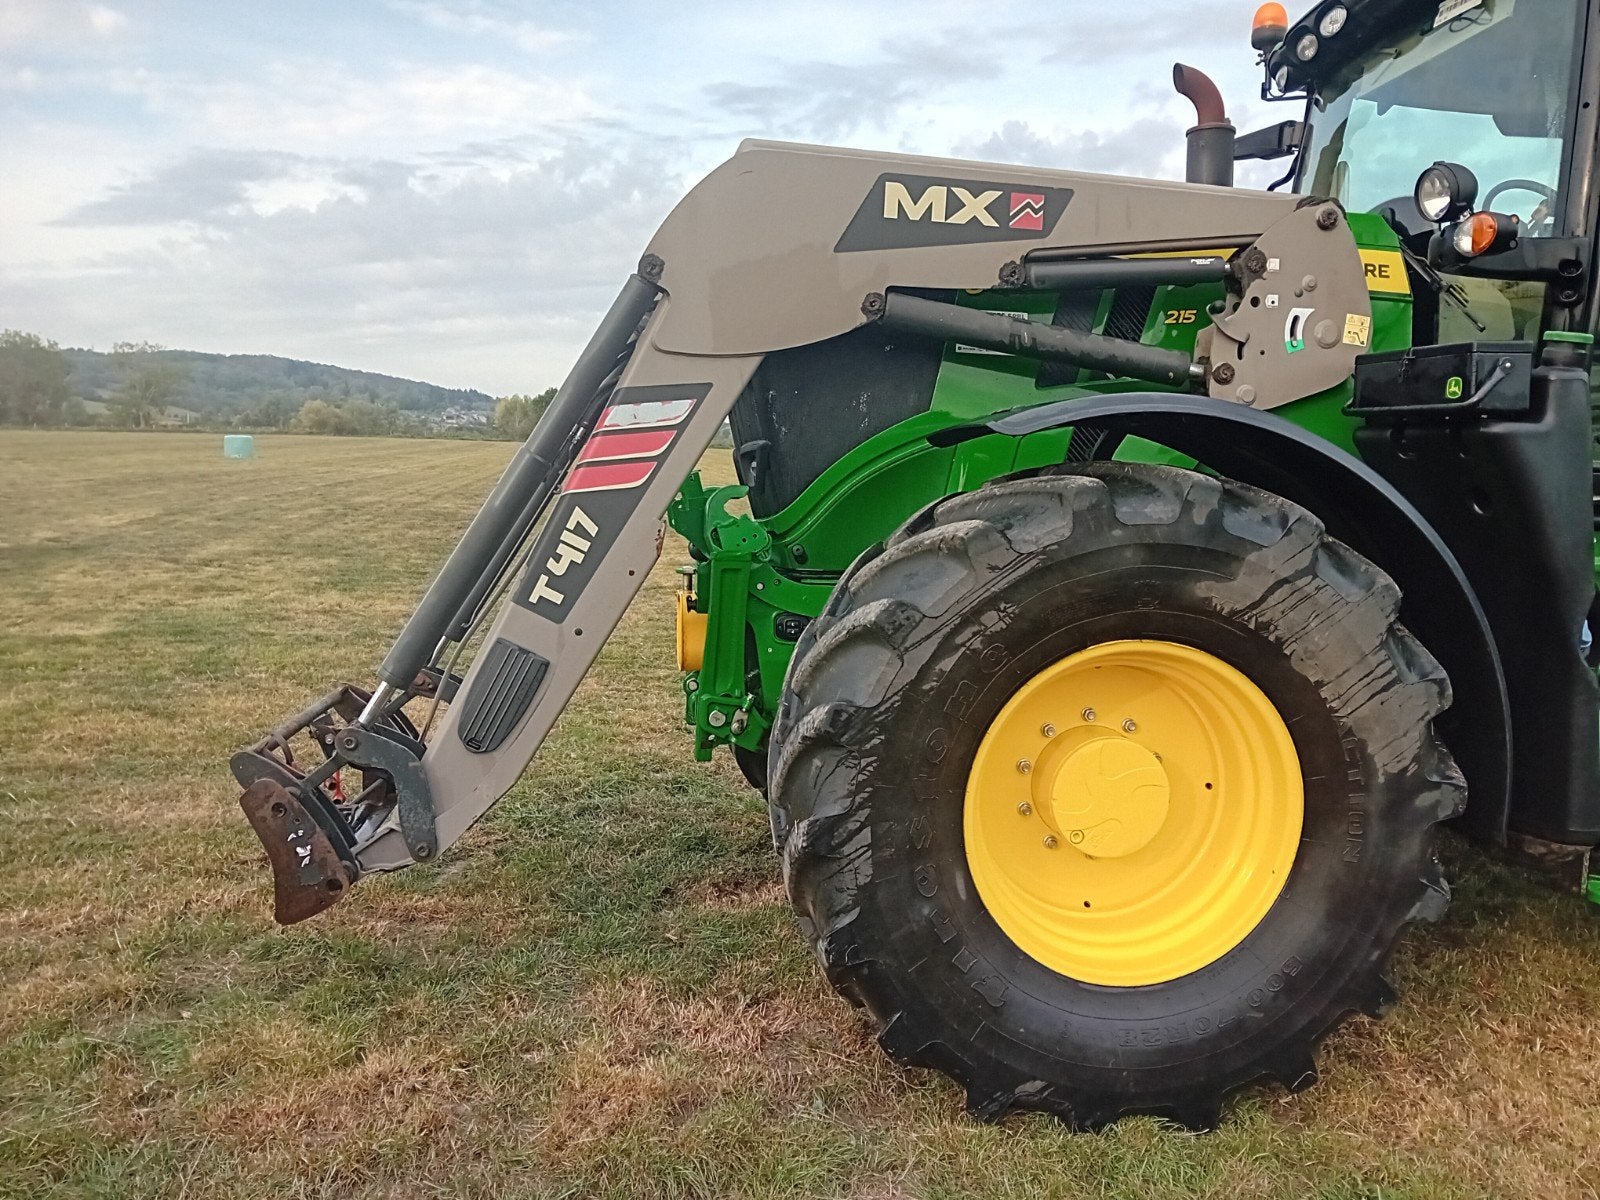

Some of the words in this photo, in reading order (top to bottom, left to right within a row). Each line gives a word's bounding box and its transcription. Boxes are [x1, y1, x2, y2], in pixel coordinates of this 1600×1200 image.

[883, 181, 1004, 228] MX
[1363, 262, 1391, 279] RE
[1164, 309, 1198, 325] 215
[545, 505, 600, 577] 417
[528, 573, 565, 606] T
